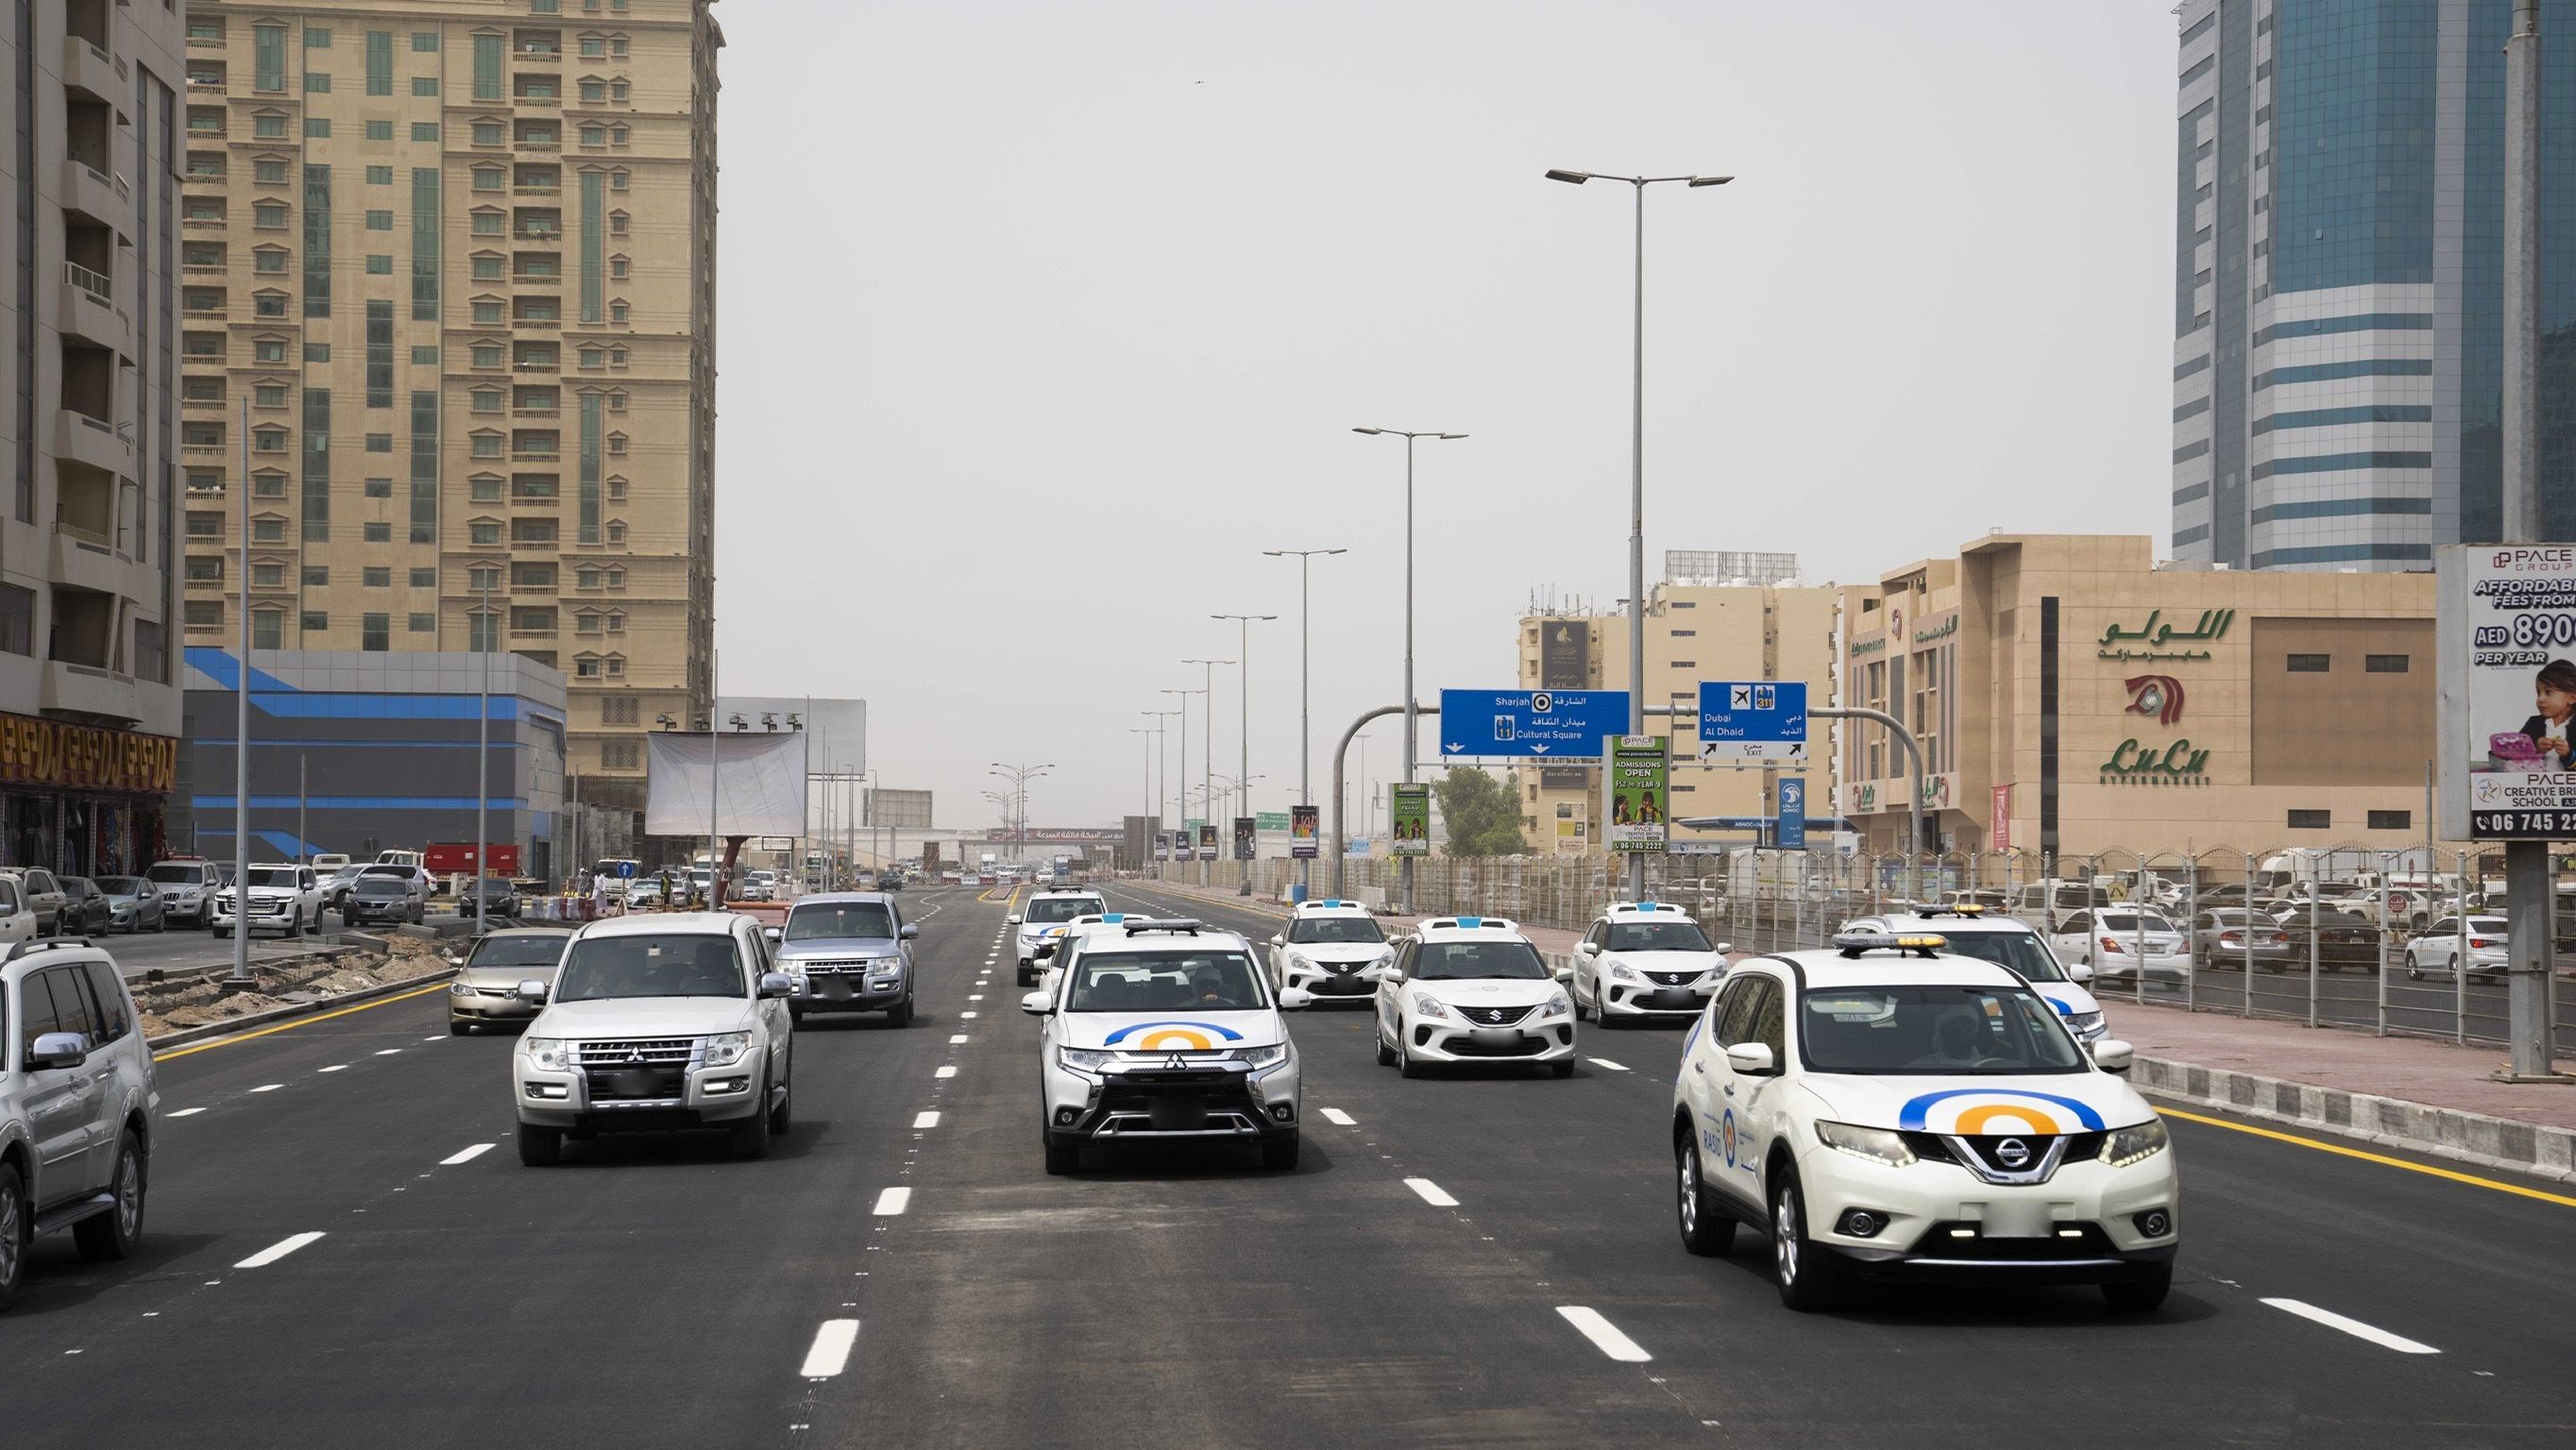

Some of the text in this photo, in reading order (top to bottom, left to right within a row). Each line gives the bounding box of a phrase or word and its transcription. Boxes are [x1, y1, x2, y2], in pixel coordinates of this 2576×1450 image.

[2516, 549, 2572, 563] PACE
[2516, 563, 2573, 572] GROUP
[2493, 593, 2576, 607] FEES FROM
[2097, 609, 2236, 646] اللولو
[2475, 614, 2576, 646] AED 890
[2097, 649, 2212, 663] هايبرماركت
[2474, 651, 2547, 664] PER YEAR
[1495, 697, 1530, 707] Sharjah
[1553, 697, 1586, 706] الشارقة
[1757, 698, 1773, 707] 311
[1532, 717, 1586, 728] ميدان الثقافة
[1704, 714, 1732, 722] Dubai
[1786, 715, 1802, 725] دبي
[1499, 728, 1511, 737] 11
[1517, 730, 1583, 741] Cultural Square
[1705, 727, 1744, 736] Al Dhaid
[1780, 727, 1802, 736] الذيد
[1625, 768, 1652, 777] OPEN
[1616, 780, 1626, 788] FS2
[1637, 780, 1653, 788] YEAR
[2100, 775, 2211, 786] HYPERMARKET
[2528, 774, 2576, 784] PACE
[2504, 786, 2556, 797] CREATIVE
[2512, 798, 2558, 807] SCHOOL
[2492, 814, 2514, 831] 06
[2521, 814, 2553, 831] 745
[1703, 1130, 1721, 1156] RASID
[2000, 1149, 2025, 1157] NISSAN
